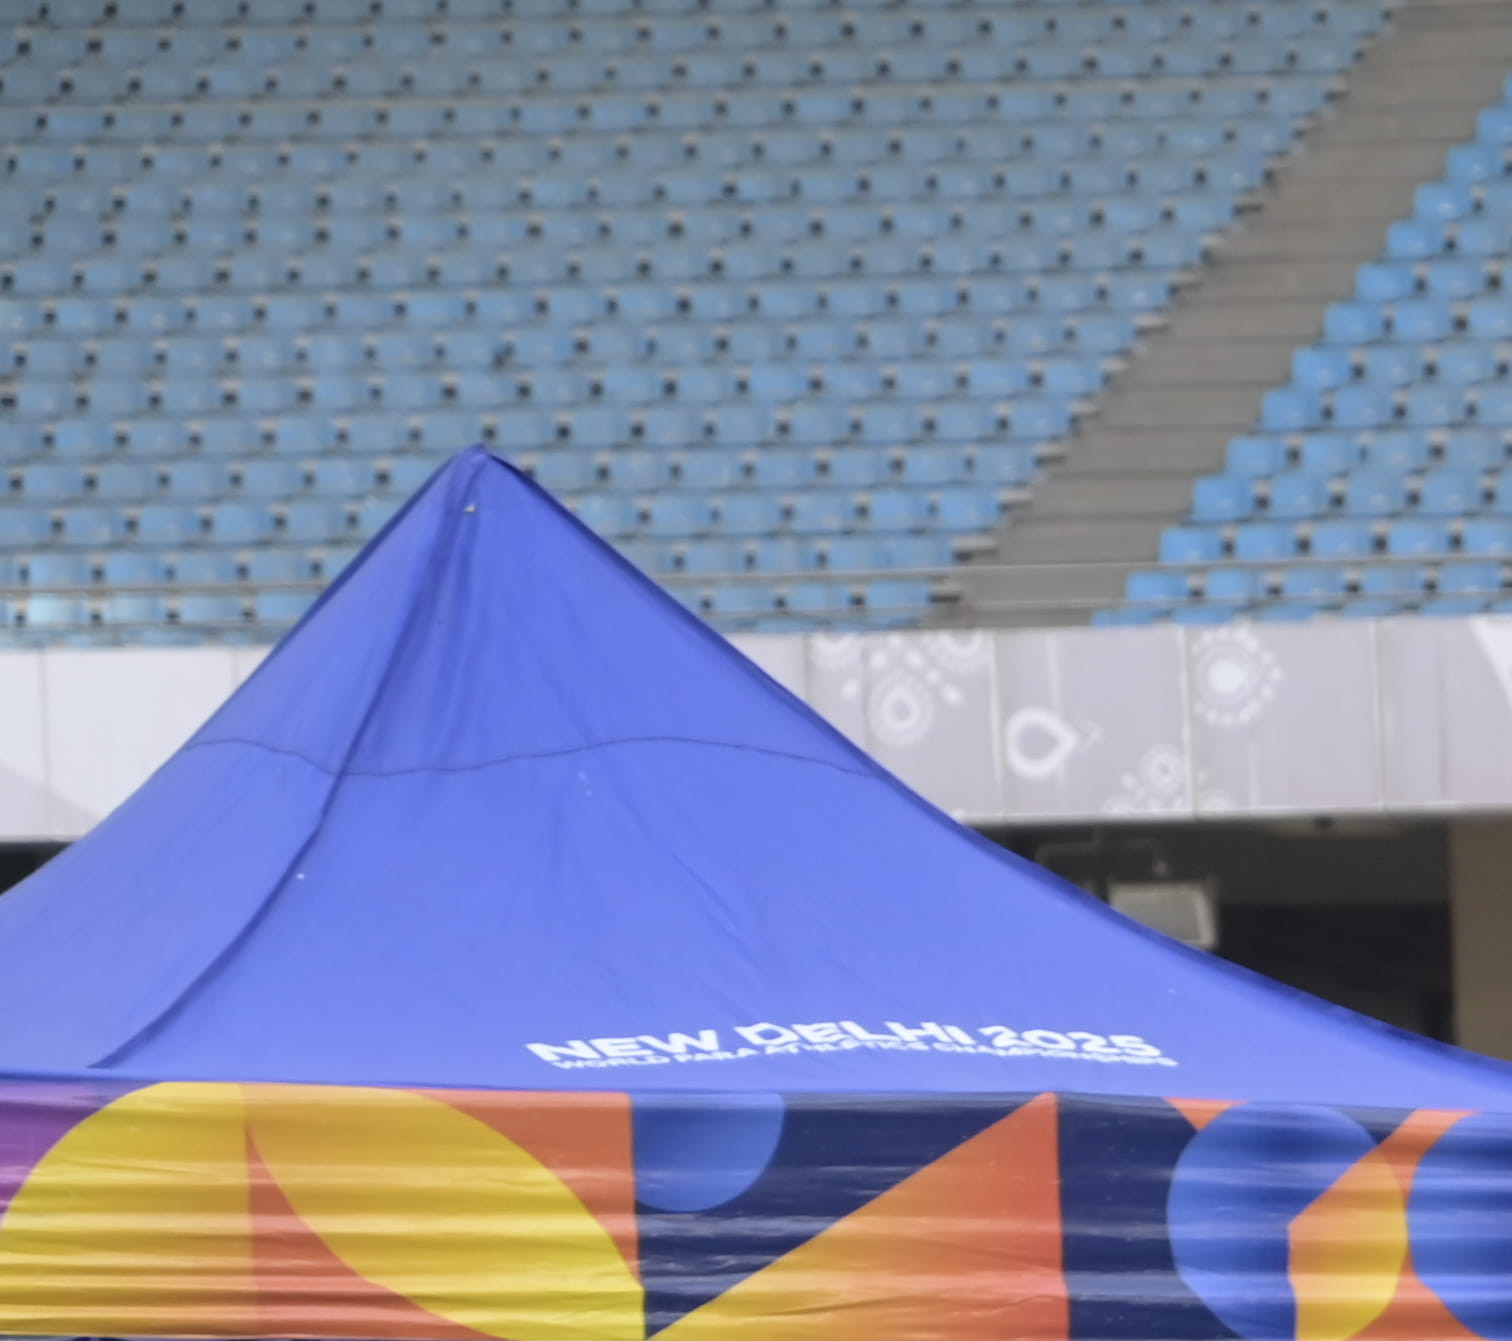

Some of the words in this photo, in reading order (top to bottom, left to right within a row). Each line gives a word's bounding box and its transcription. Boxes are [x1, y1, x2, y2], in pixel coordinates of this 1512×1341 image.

[526, 1029, 719, 1062] NEW
[734, 1020, 976, 1047] DELHI
[978, 1025, 1162, 1057] 2025
